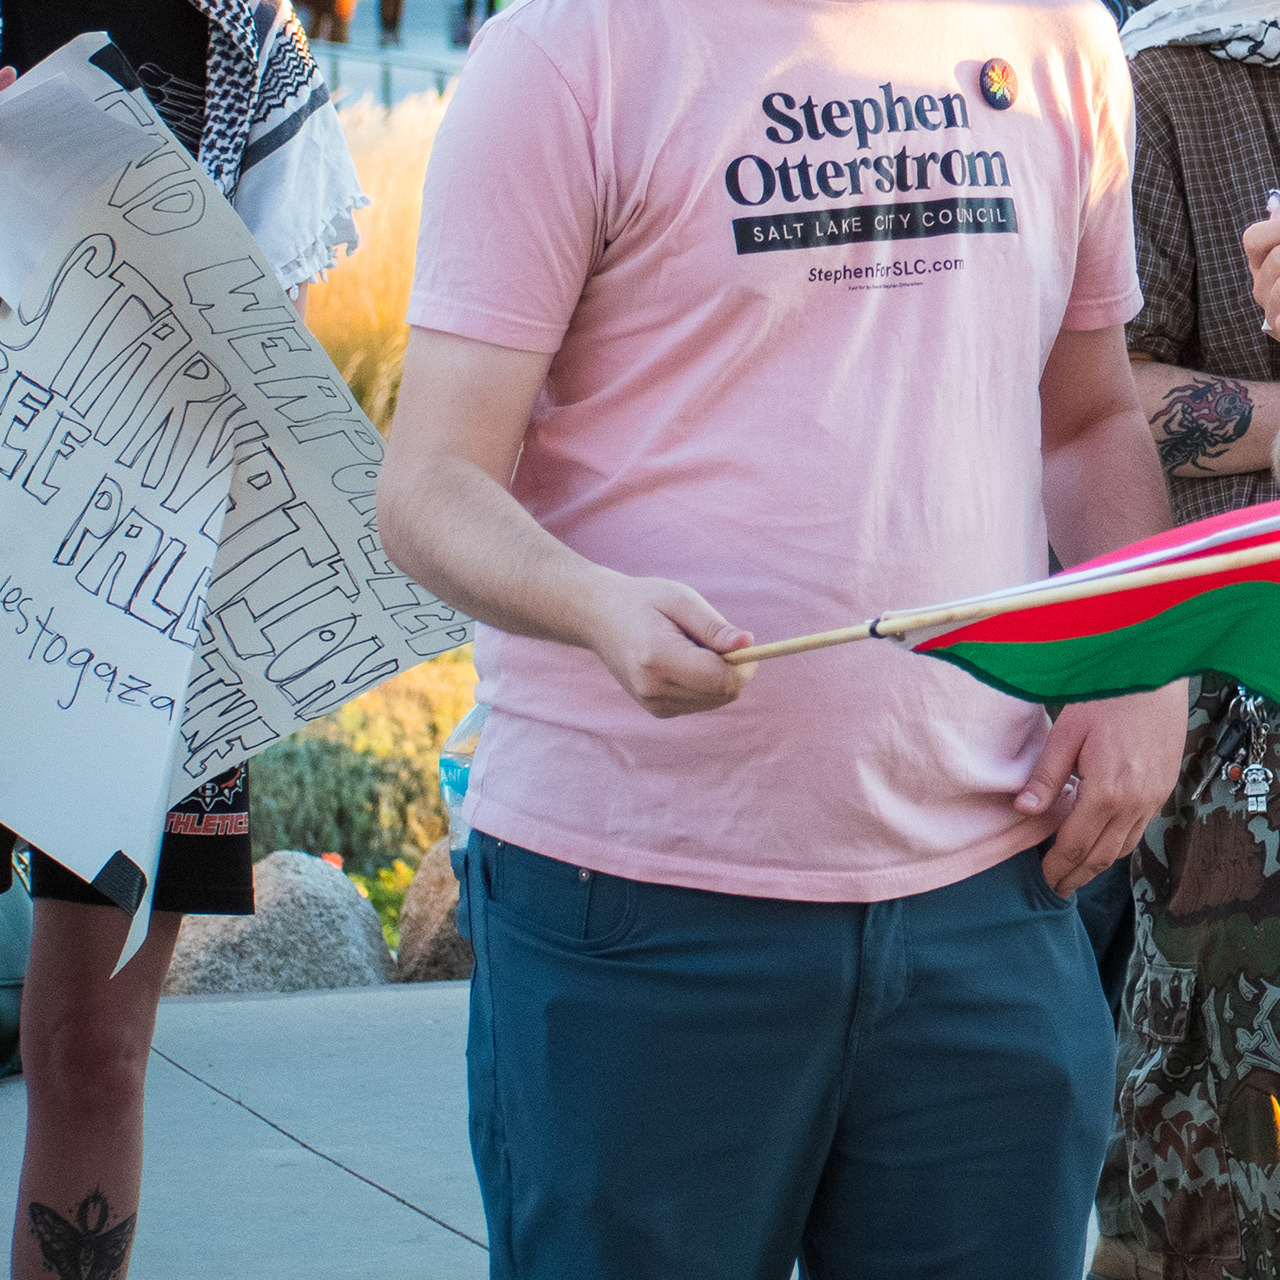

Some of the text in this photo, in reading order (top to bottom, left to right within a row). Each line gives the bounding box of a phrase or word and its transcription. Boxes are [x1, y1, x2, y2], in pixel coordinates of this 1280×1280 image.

[761, 81, 971, 150] Stephen
[724, 145, 1012, 207] Otterstrom
[753, 207, 1007, 243] SALT LAKE CITY COUNCIL
[808, 258, 965, 284] StephenForSLC.com
[0, 233, 400, 722] STARVATION
